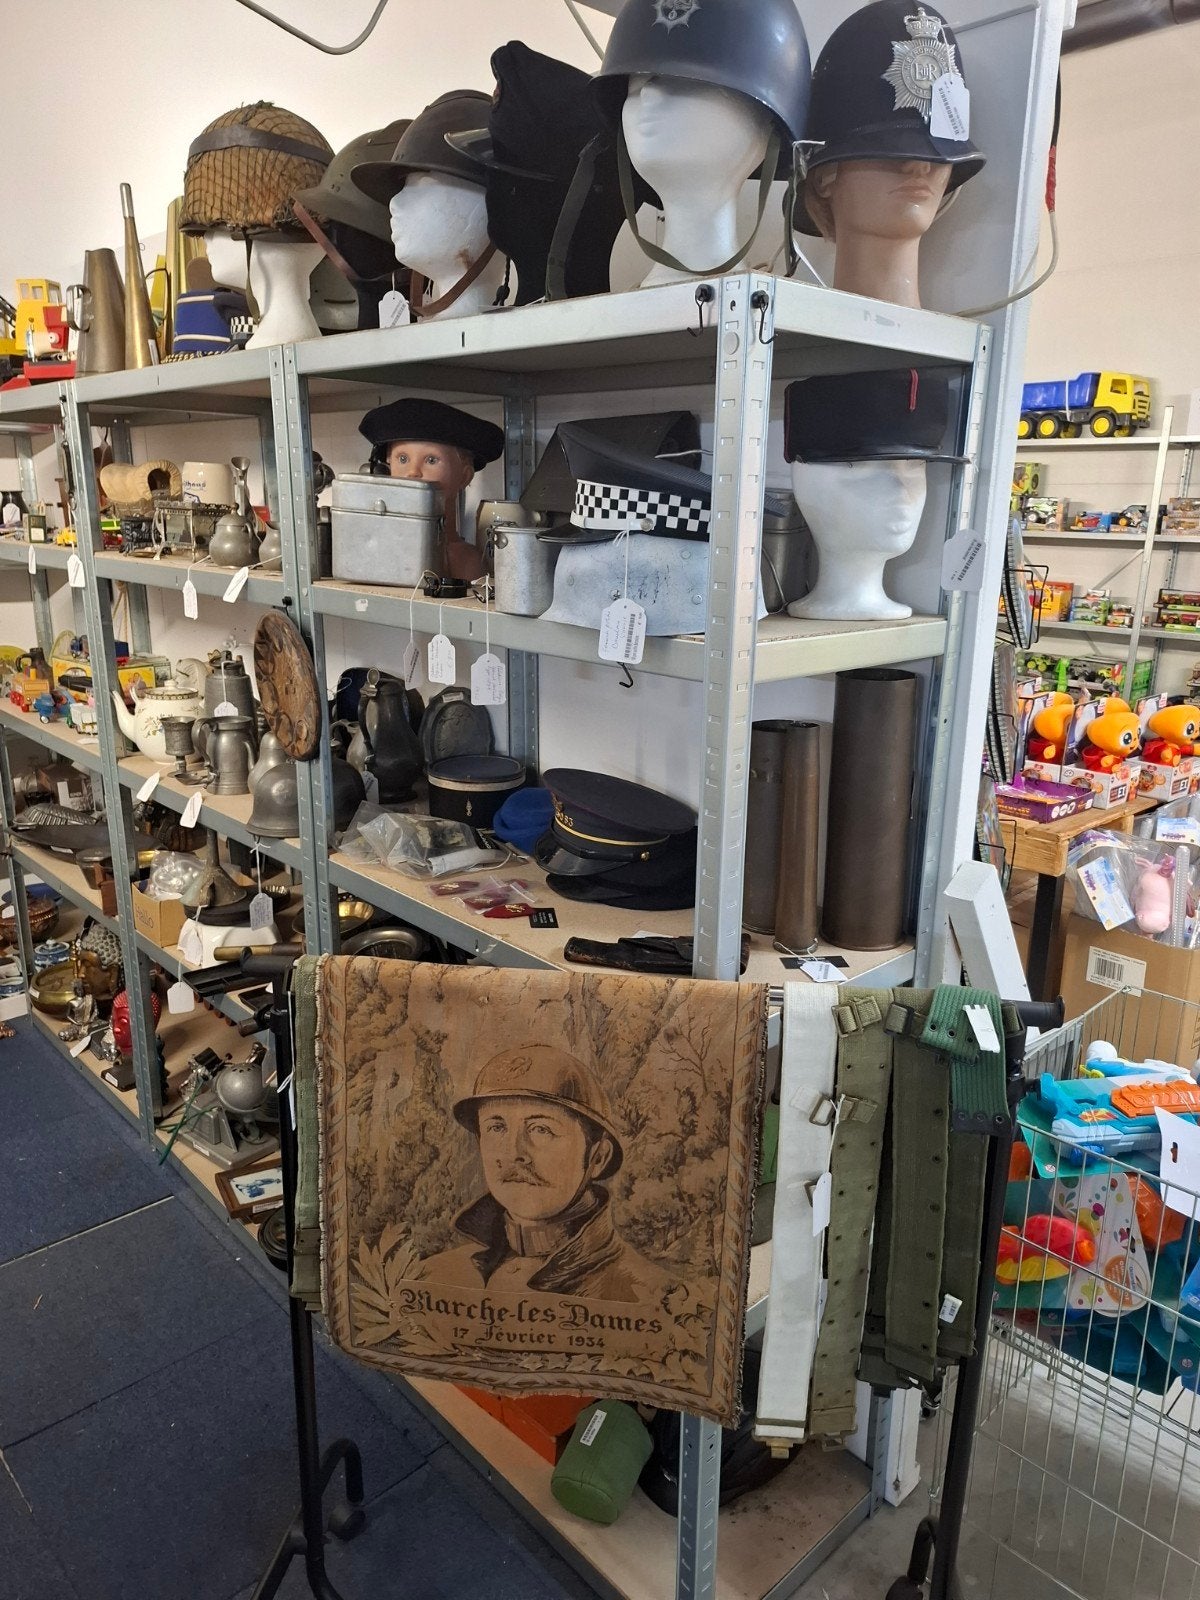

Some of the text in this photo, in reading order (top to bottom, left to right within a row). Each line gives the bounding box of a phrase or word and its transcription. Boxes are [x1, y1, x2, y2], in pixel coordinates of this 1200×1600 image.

[399, 1288, 663, 1334] Marche-les-Dames
[453, 1326, 470, 1340] 17
[568, 1334, 605, 1348] 1934
